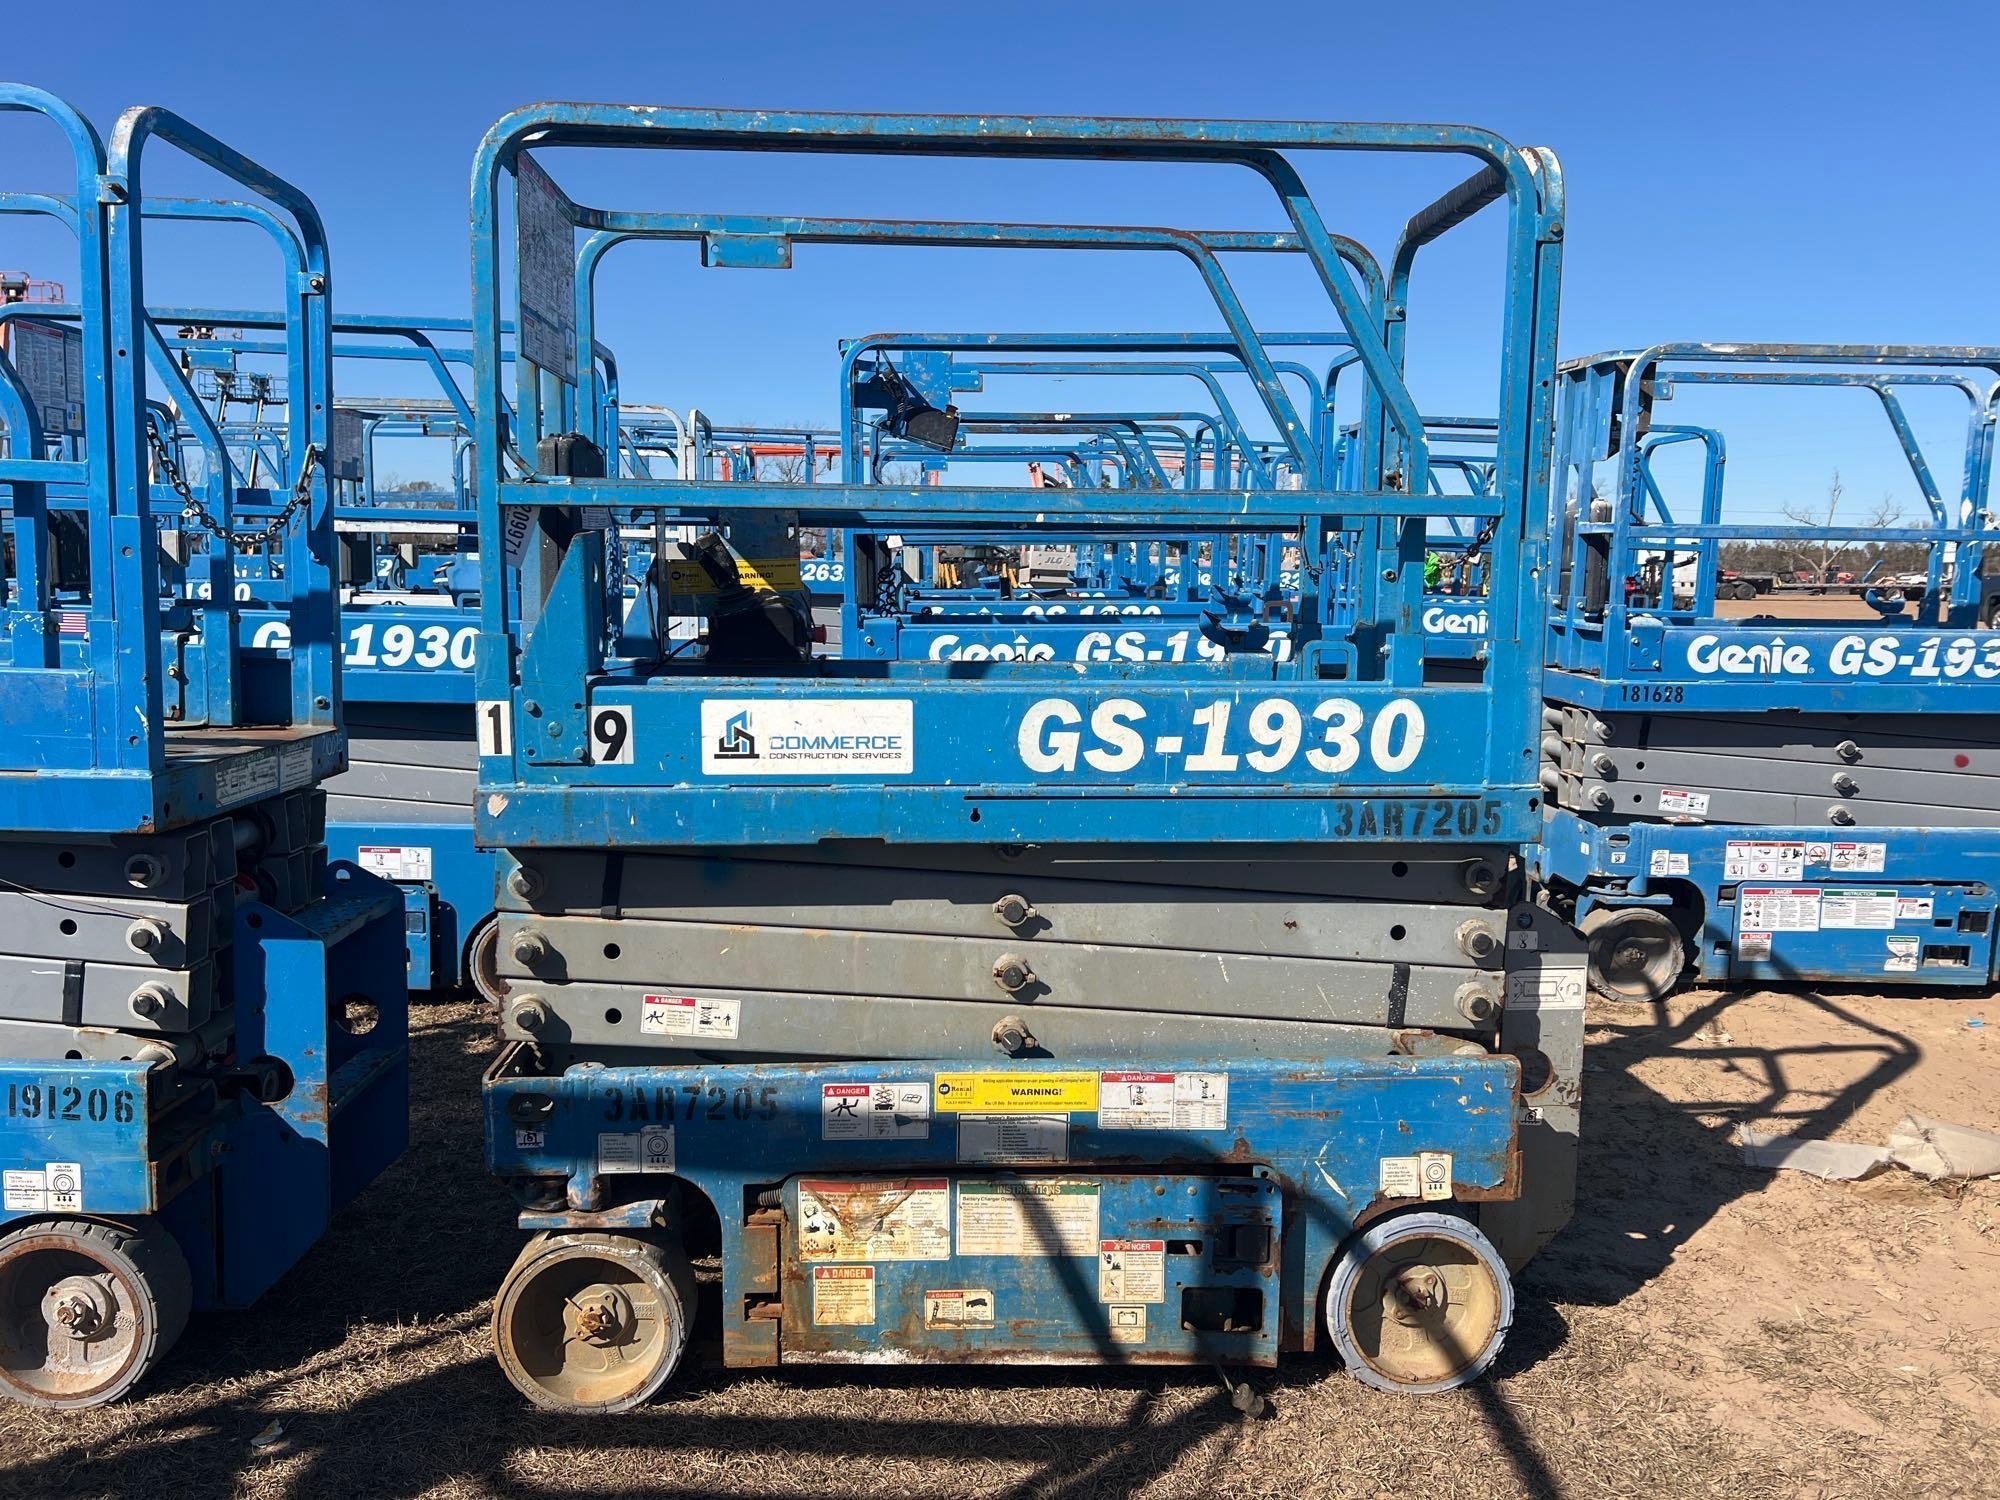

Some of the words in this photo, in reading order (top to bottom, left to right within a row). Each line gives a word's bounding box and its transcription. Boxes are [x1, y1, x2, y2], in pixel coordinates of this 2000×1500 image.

[739, 571, 774, 580] ARNING!
[1423, 607, 1488, 634] Geni
[252, 620, 477, 668] G1930
[929, 634, 1055, 661] Genie
[1076, 631, 1291, 661] GS-190
[1687, 635, 1810, 674] Genie
[1621, 685, 1684, 703] 181628
[770, 735, 902, 750] COMMERCE
[1018, 698, 1426, 773] GS-1930
[769, 752, 848, 760] CONSTRUCTION
[852, 752, 902, 760] SERVICES
[1334, 800, 1502, 837] 3AR7205
[9, 1084, 133, 1123] 191206
[604, 1087, 777, 1121] 3AR7205
[1011, 1088, 1062, 1097] WARNING!
[860, 1182, 894, 1191] DANGER
[833, 1268, 867, 1278] DANGER
